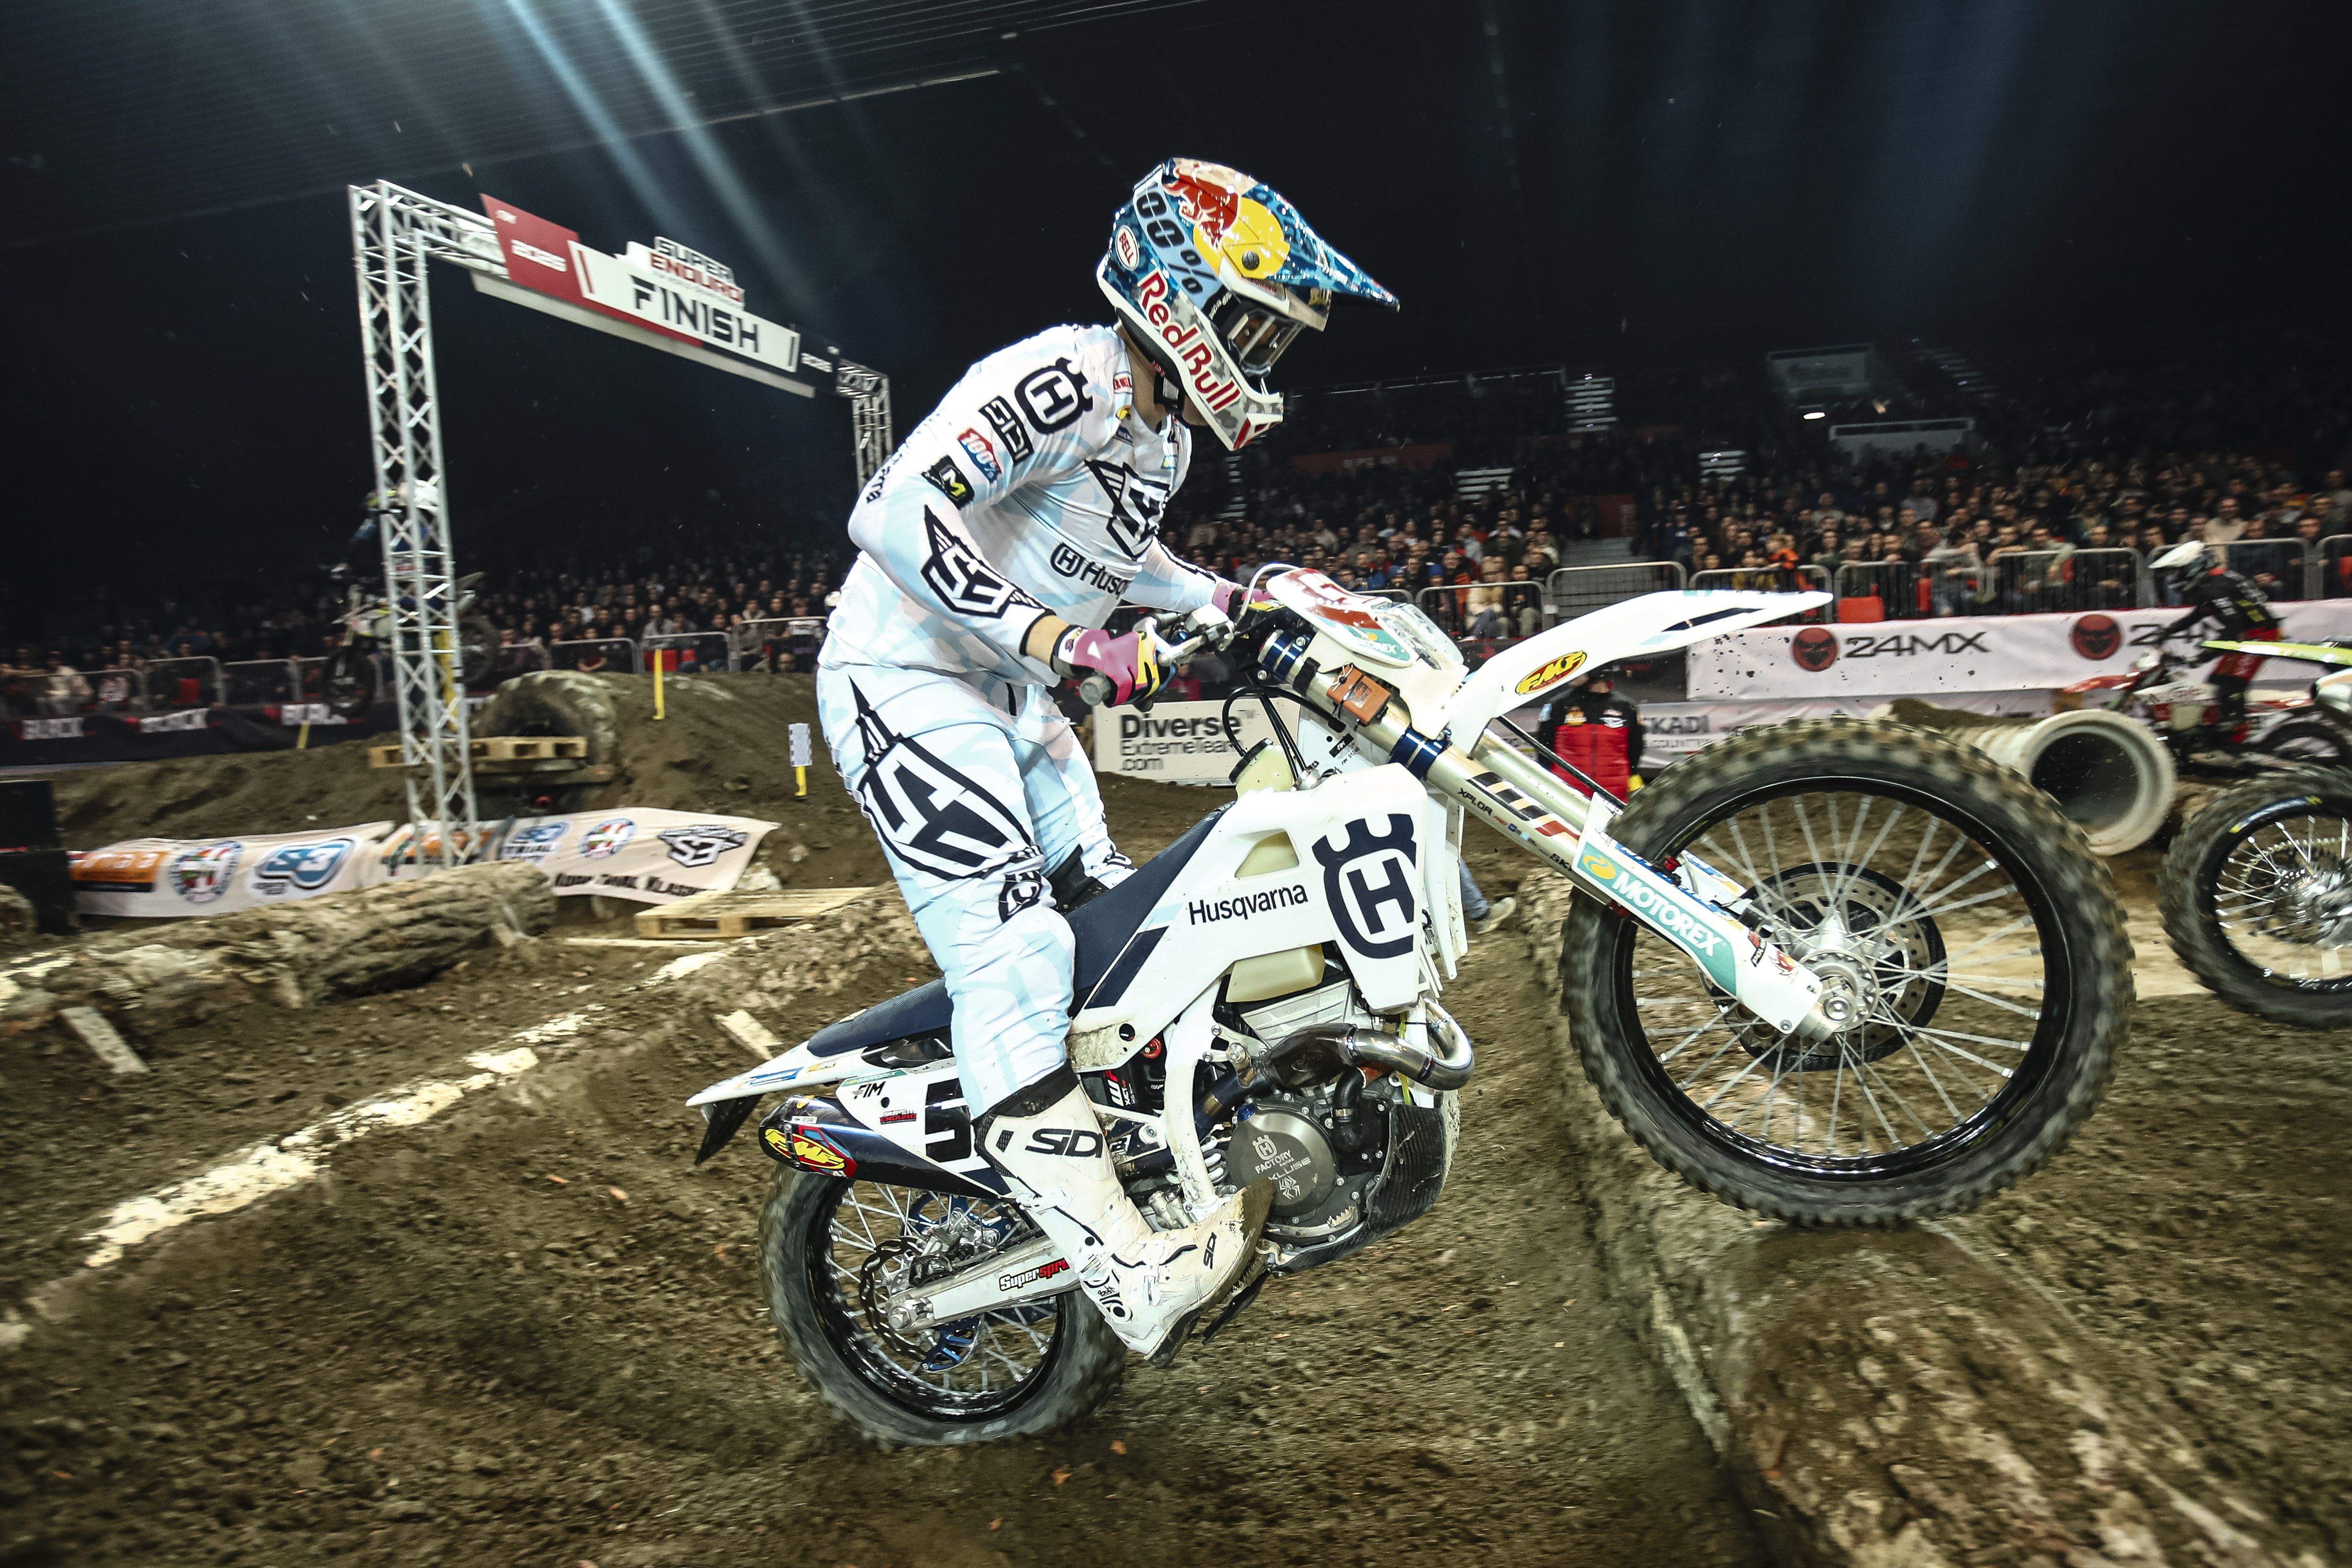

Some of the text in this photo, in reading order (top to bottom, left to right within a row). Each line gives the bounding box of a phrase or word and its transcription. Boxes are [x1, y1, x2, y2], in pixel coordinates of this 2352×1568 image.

[658, 239, 734, 281] SUPER
[1119, 231, 1134, 266] BELL
[651, 253, 745, 302] ENDURO
[629, 274, 759, 353] FINISH
[1140, 273, 1198, 349] Red
[1182, 342, 1241, 412] Bull
[1845, 631, 1991, 658] 24MX
[1519, 651, 1583, 695] FMF
[1120, 713, 1241, 738] Diverse
[1458, 788, 1493, 815] XPLOR
[1189, 883, 1308, 925] Husqvarna
[1612, 871, 1724, 957] MOTOREX
[852, 1081, 886, 1099] FIM
[881, 1114, 916, 1122] ENDURO
[765, 1131, 845, 1164] FMF
[1255, 1149, 1291, 1174] FACTORY
[1279, 1157, 1294, 1167] RACING
[1268, 1157, 1311, 1180] KLUSE
